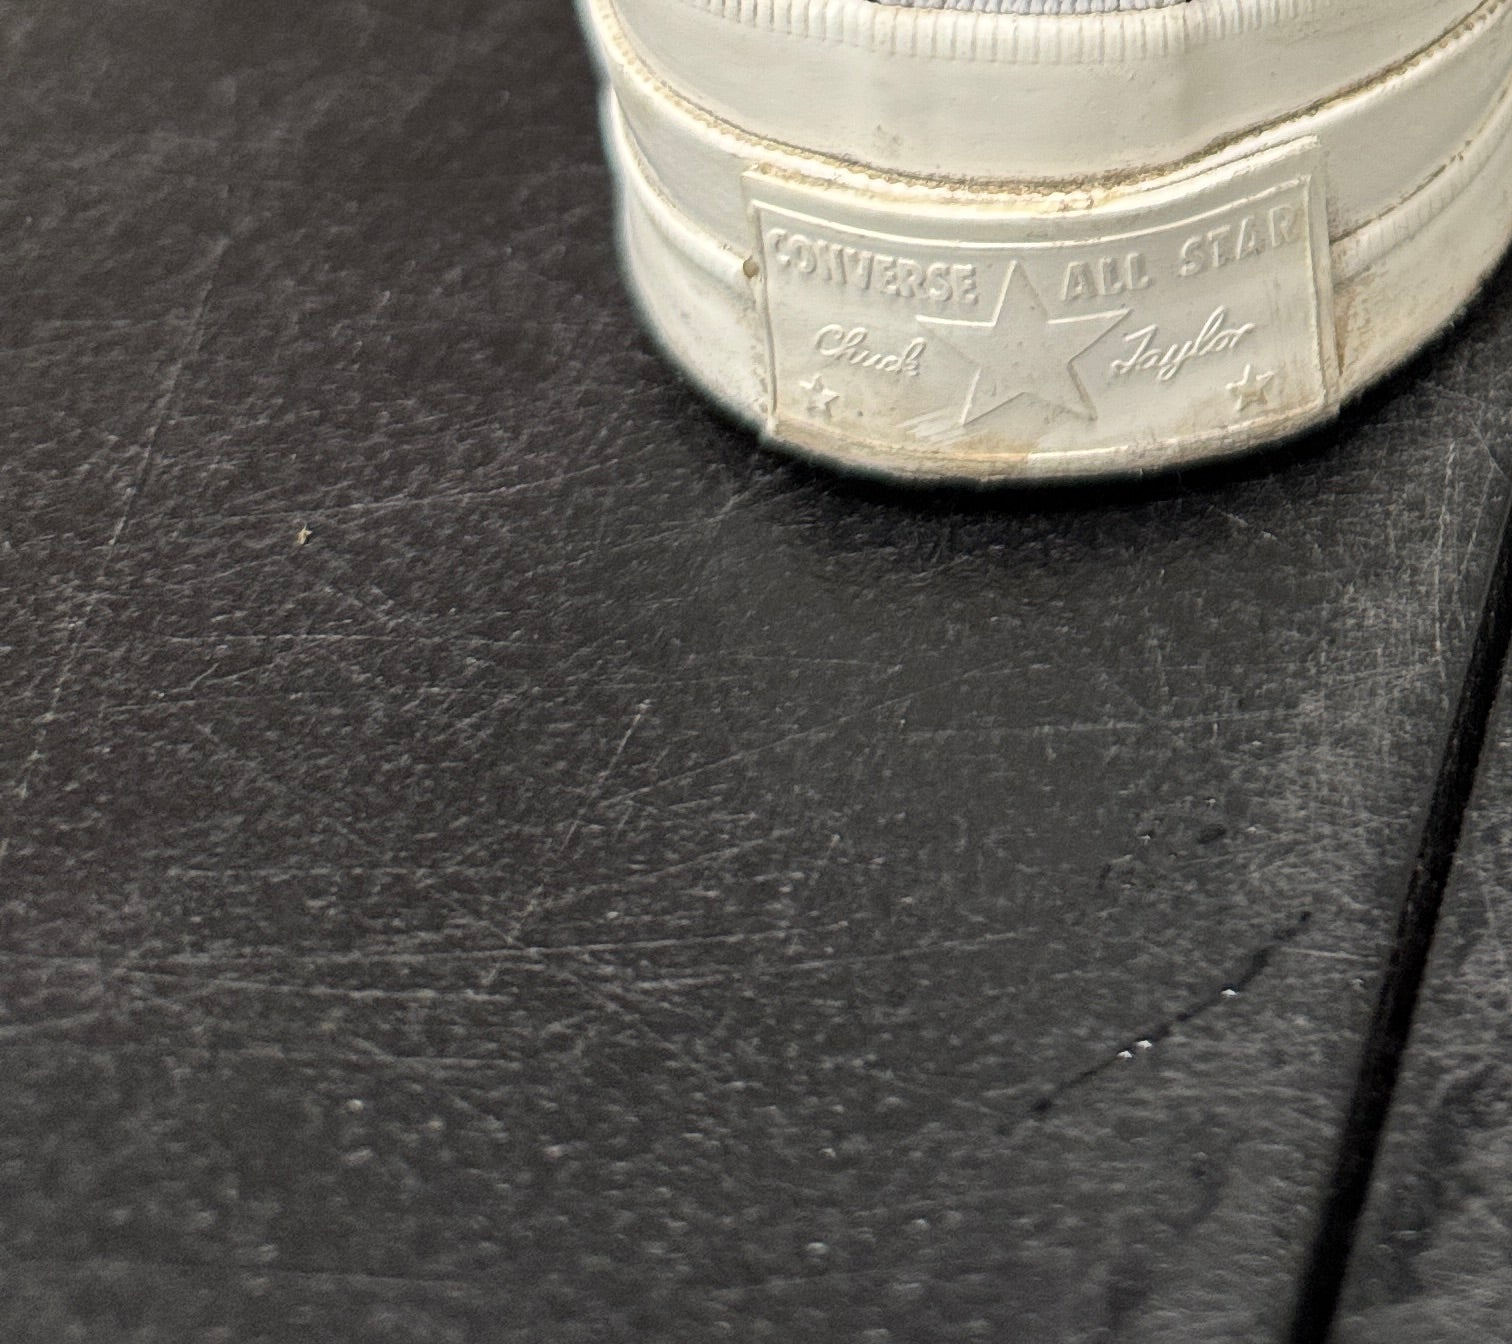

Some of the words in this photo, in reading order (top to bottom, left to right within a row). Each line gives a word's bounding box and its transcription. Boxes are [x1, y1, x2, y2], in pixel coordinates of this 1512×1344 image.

[766, 225, 981, 305] CONVERSE
[1060, 250, 1154, 302] ALL
[1176, 204, 1299, 279] STAR
[813, 322, 928, 379] Chuck
[1109, 304, 1258, 383] Taylor
